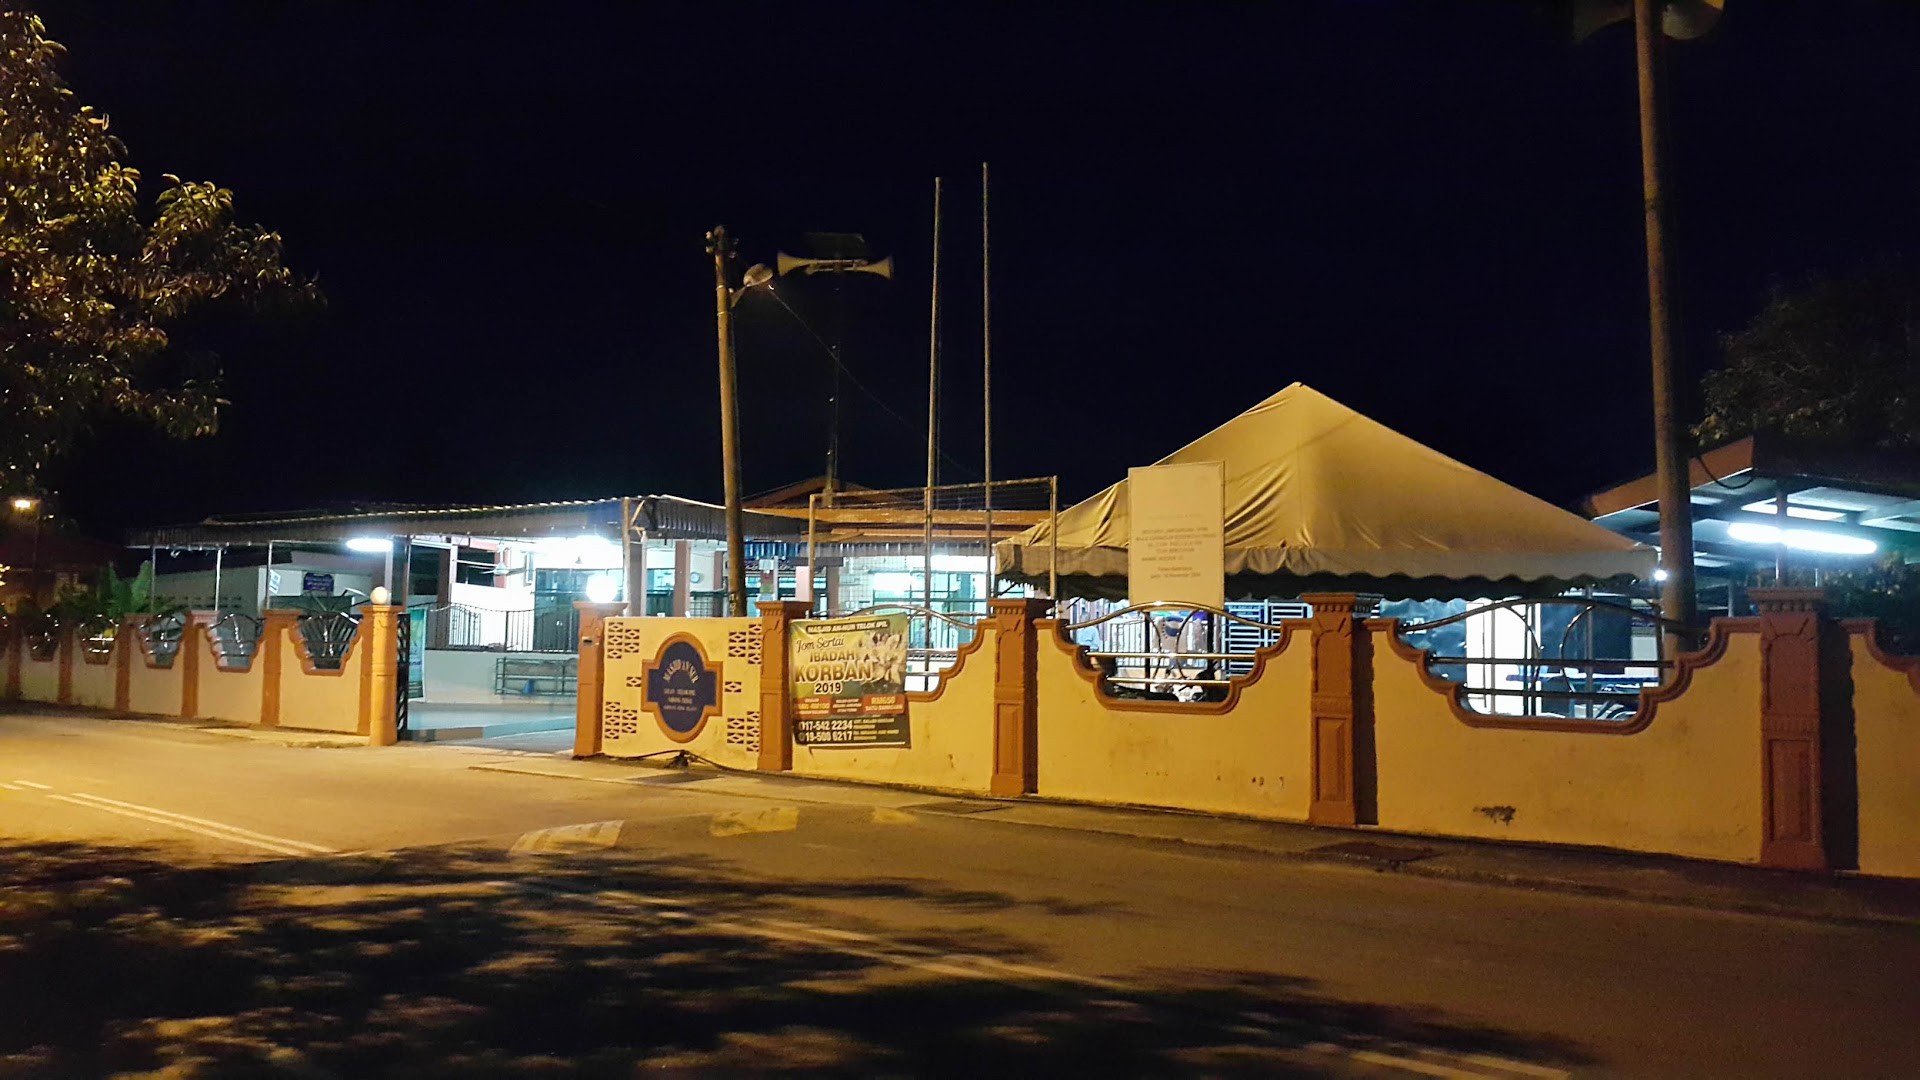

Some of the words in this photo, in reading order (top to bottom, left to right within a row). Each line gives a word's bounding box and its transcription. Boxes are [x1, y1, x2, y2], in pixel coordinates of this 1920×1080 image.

[807, 625, 831, 633] MASJID
[856, 621, 875, 630] TELOK
[796, 639, 814, 653] Jom
[817, 635, 845, 648] Sertai
[810, 650, 856, 663] IBADAH
[795, 661, 872, 683] KORBAN
[815, 682, 842, 694] 2019
[831, 720, 853, 730] 2234
